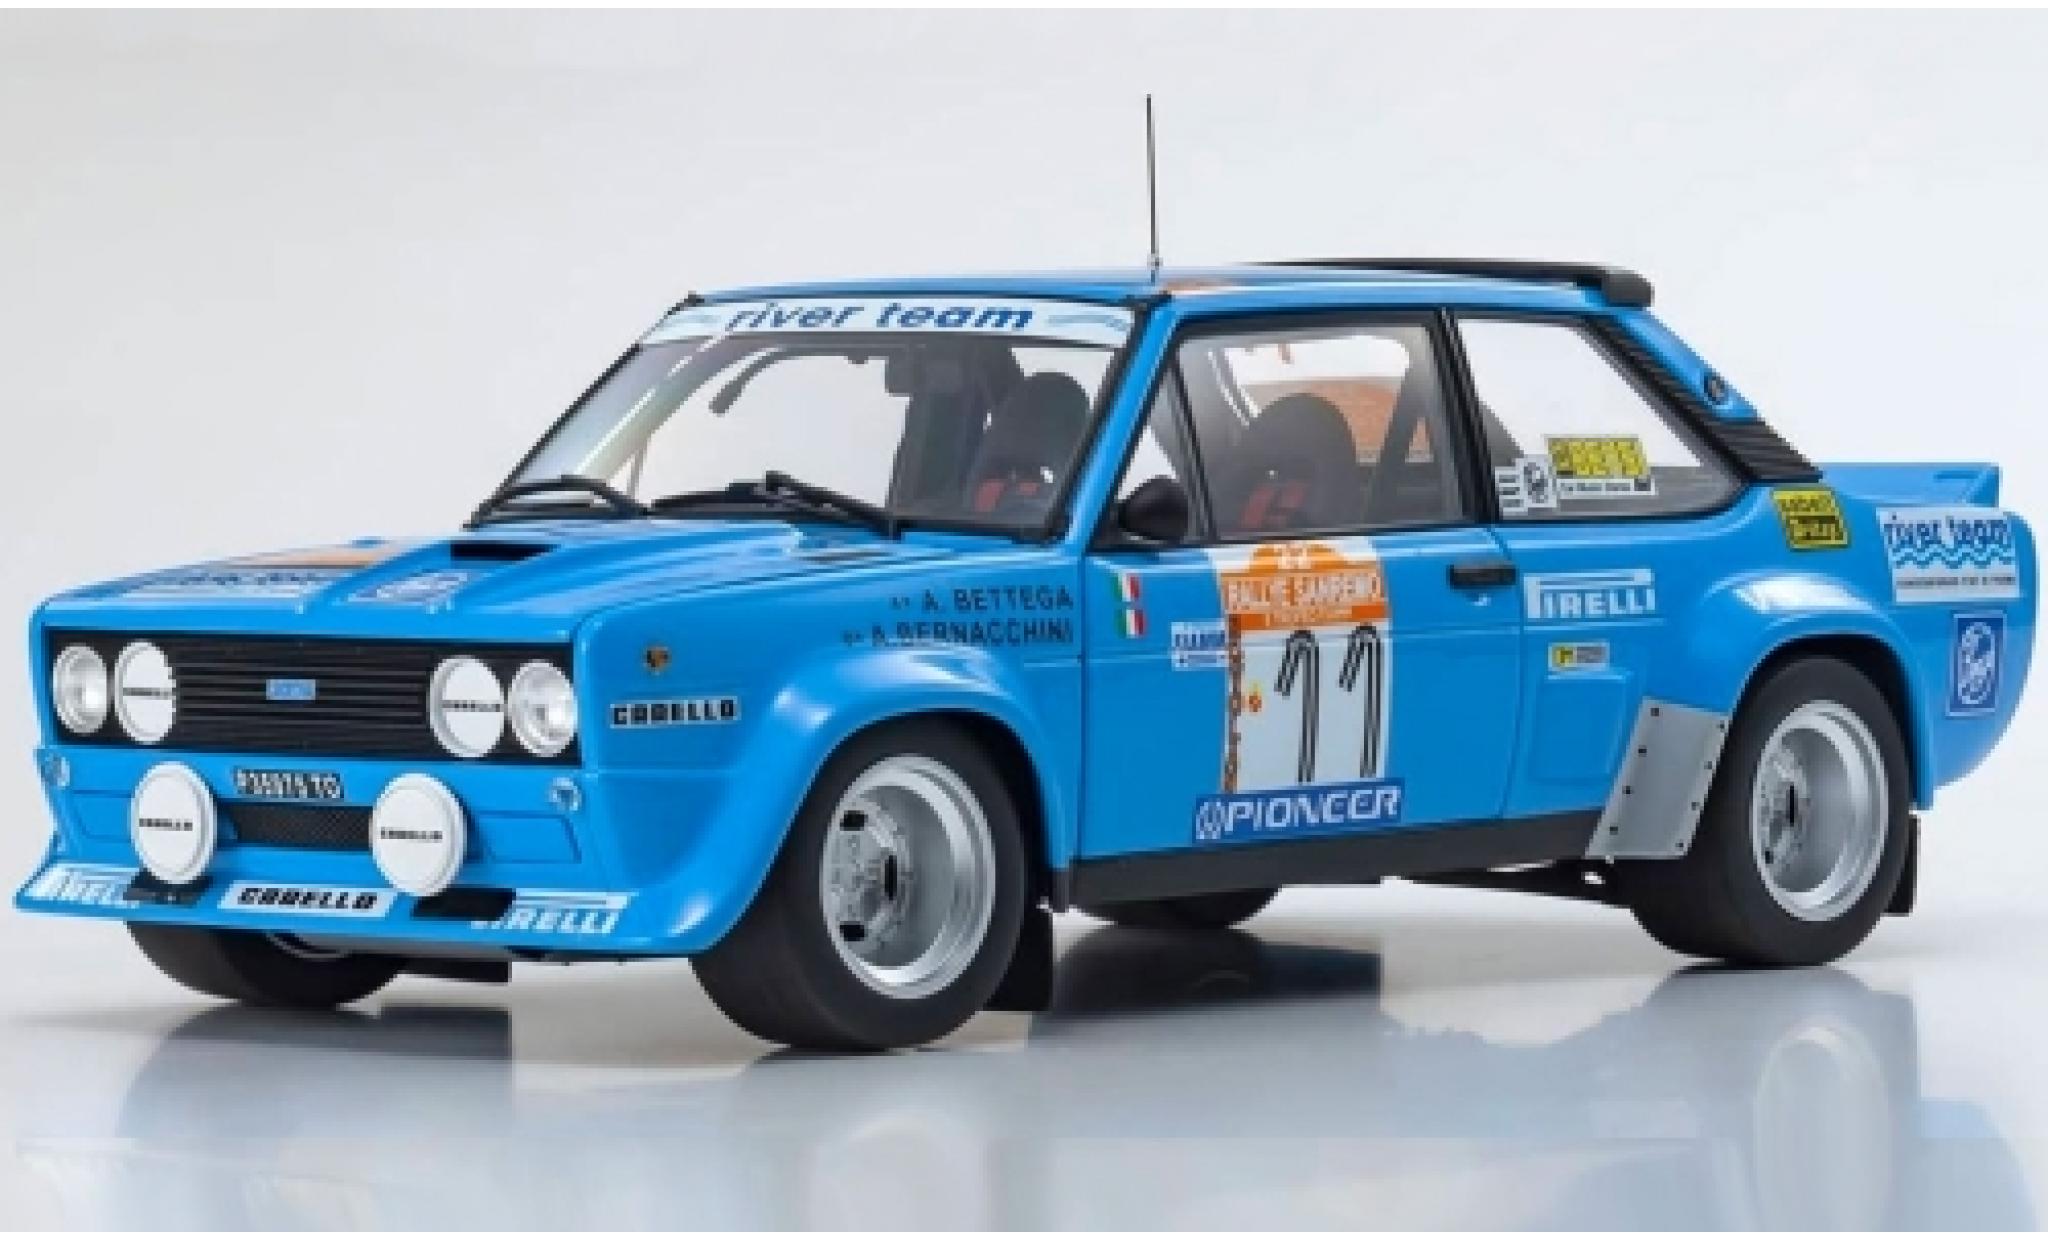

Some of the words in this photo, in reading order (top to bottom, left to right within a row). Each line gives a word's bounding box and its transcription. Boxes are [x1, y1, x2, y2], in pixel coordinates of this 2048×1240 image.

[725, 302, 865, 333] river
[876, 302, 1034, 331] team
[1885, 513, 1939, 547] river
[1945, 514, 2013, 546] team
[953, 585, 1074, 611] BETTEGA
[1227, 578, 1290, 612] RALLYE
[1299, 571, 1384, 606] SANREMO
[1524, 570, 1656, 618] PIRELLI
[612, 700, 735, 725] CARELLO
[1274, 624, 1382, 784] 11
[1223, 785, 1402, 834] PIONEER
[238, 887, 378, 911] CARELLO
